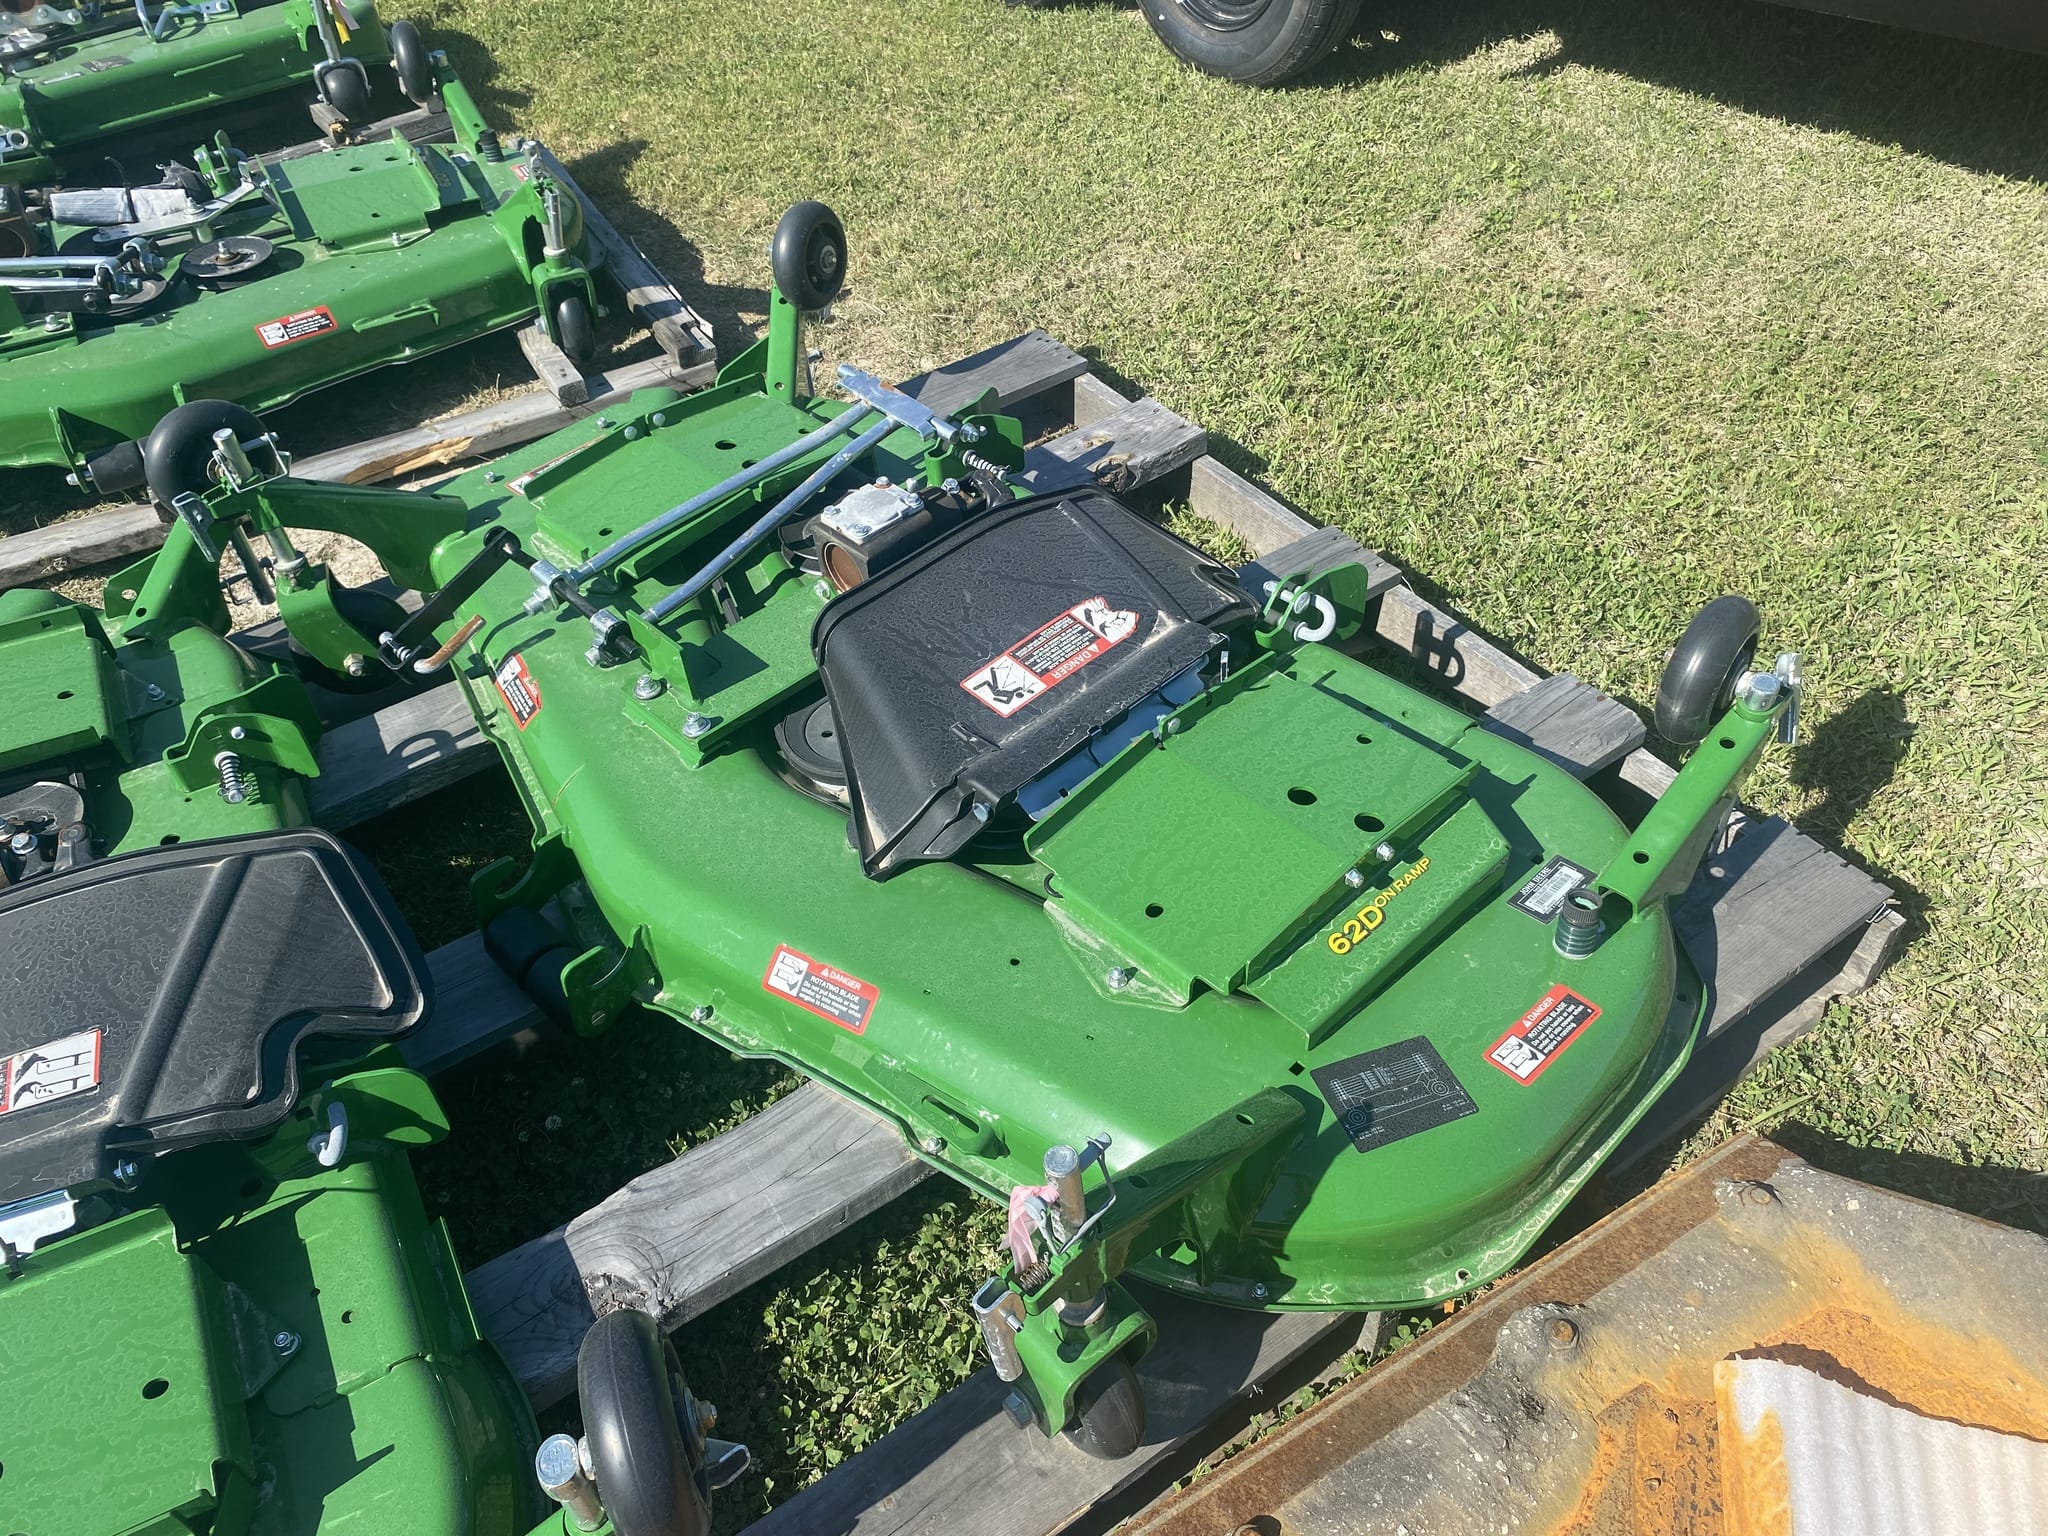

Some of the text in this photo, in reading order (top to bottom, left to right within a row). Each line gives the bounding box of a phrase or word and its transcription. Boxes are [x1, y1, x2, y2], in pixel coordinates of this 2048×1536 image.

[1049, 649, 1093, 679] DANGER
[1518, 880, 1536, 895] JOHN
[1531, 865, 1552, 883] DEERE
[1327, 857, 1432, 955] 62D ON RAMP
[808, 974, 860, 1003] ROTATING BLADE
[828, 970, 862, 991] DANGER
[1525, 995, 1556, 1022] DANGER
[1526, 1000, 1568, 1039] ROTATING BLADE
